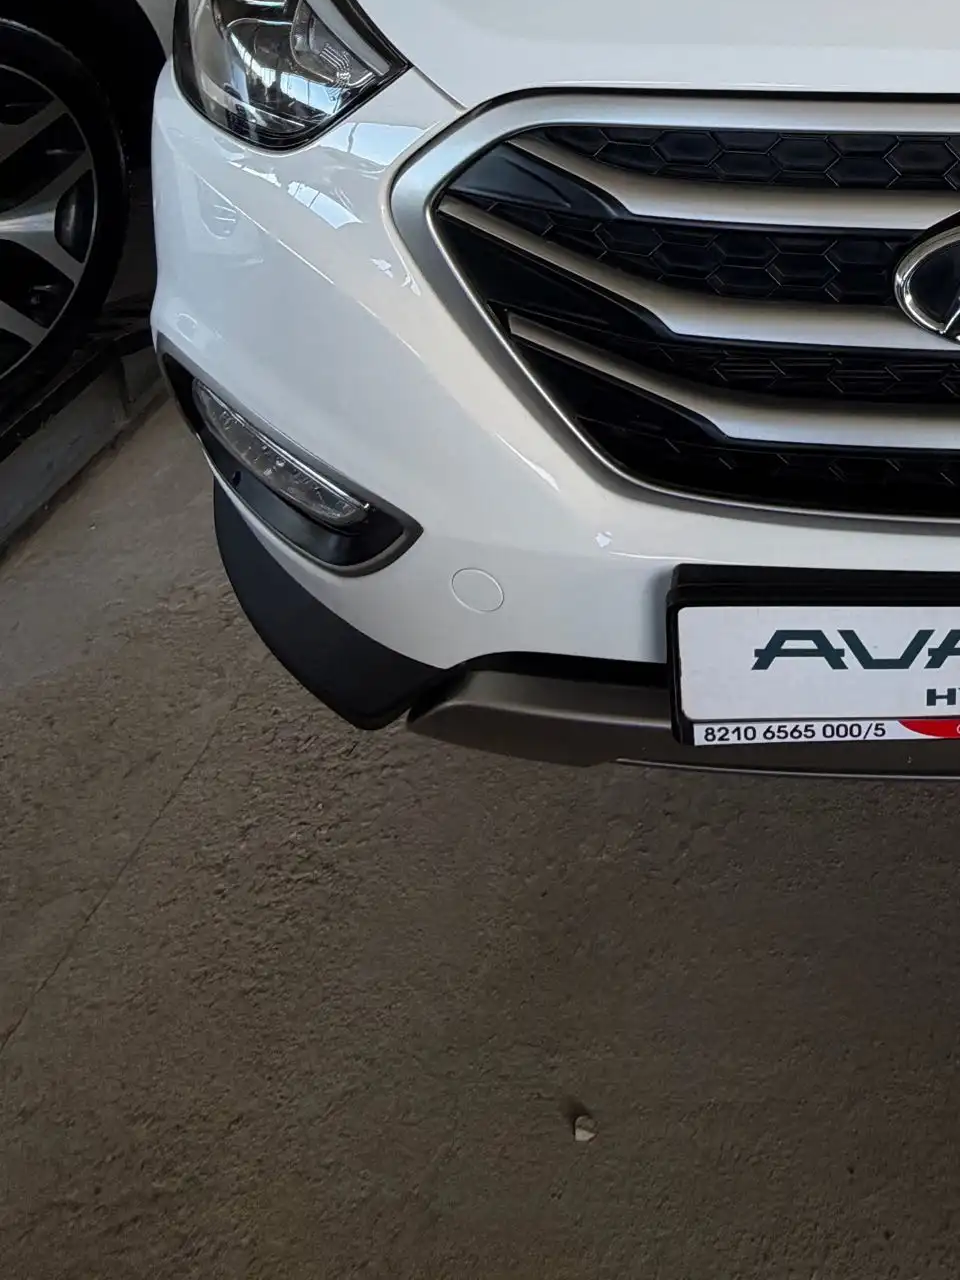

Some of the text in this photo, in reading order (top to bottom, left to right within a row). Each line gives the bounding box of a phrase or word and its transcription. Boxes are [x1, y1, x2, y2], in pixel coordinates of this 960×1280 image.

[703, 721, 887, 742] 8210 6565 000/5
